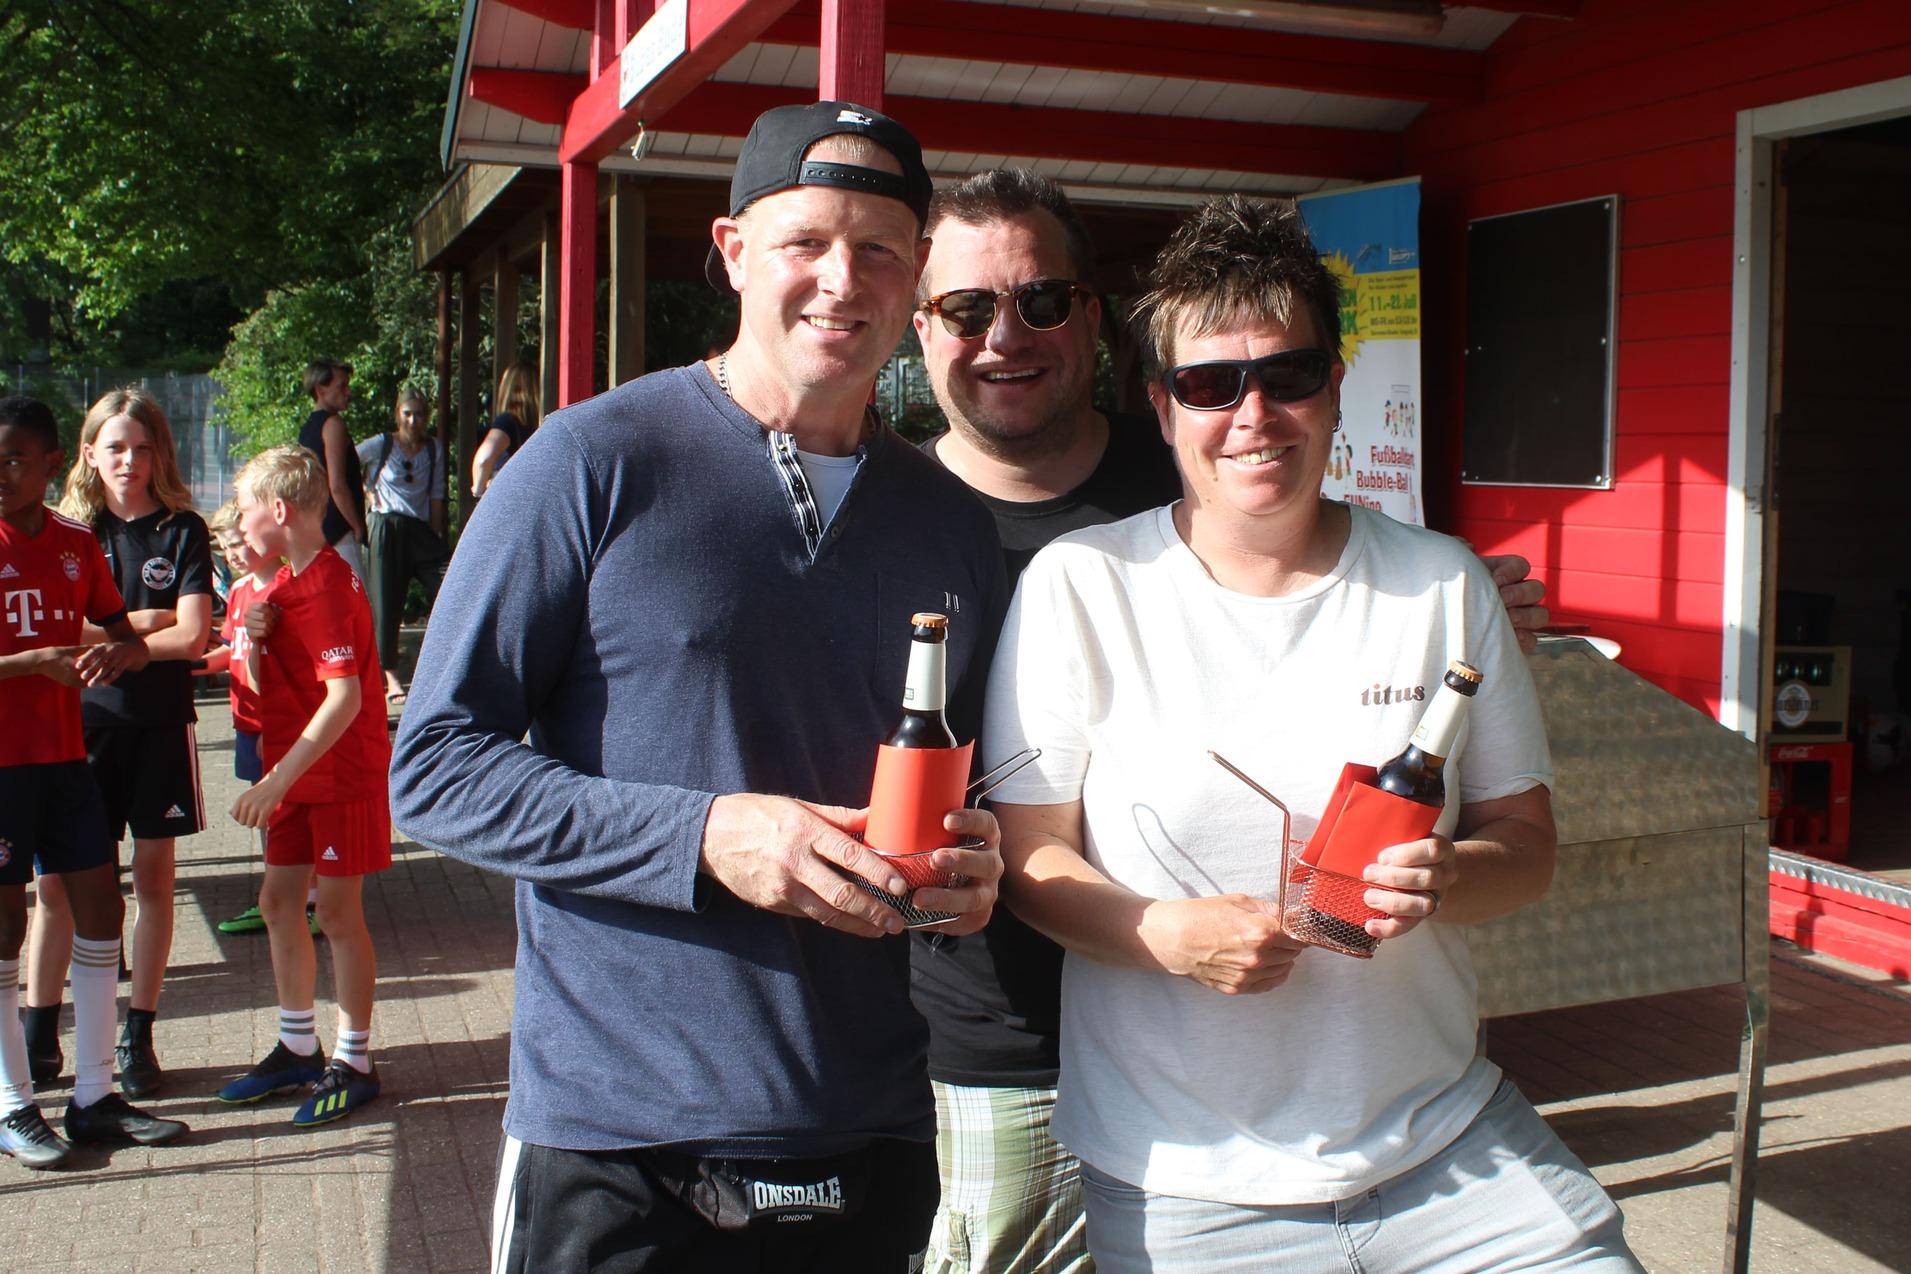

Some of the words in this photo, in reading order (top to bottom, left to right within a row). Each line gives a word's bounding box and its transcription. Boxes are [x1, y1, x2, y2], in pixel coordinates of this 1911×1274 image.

[321, 645, 353, 661] QATAR
[1361, 684, 1425, 706] titus
[753, 1176, 841, 1210] ONSDALE
[777, 1214, 813, 1222] LONDON
